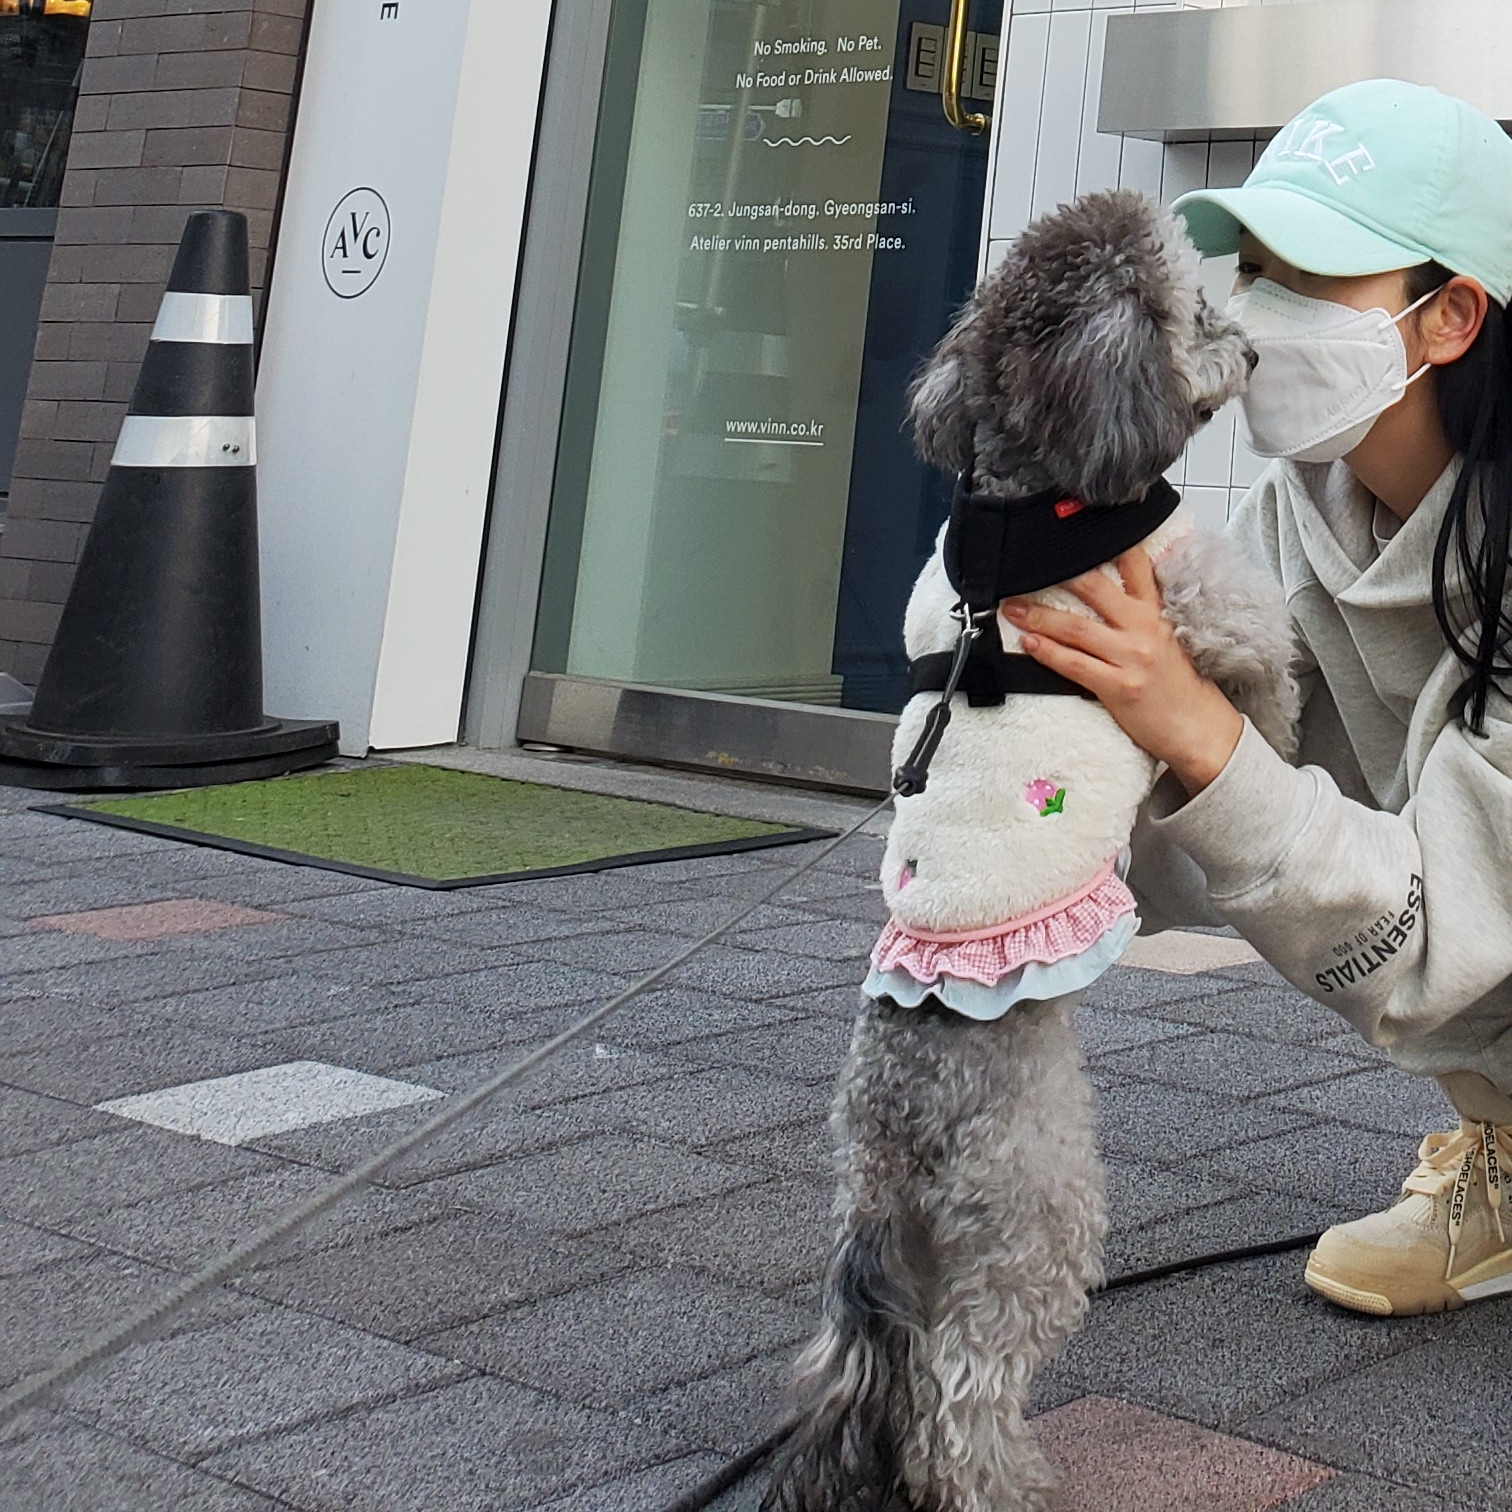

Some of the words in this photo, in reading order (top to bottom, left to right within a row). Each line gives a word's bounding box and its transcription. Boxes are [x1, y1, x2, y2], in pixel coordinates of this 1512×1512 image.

[754, 40, 771, 56] No
[837, 37, 855, 52] No
[858, 36, 882, 51] Pet.
[736, 73, 753, 88] No
[756, 70, 786, 87] Food
[788, 74, 801, 86] or
[804, 69, 836, 85] Drink
[840, 65, 894, 83] Allowed.
[329, 211, 382, 260] AVC
[690, 235, 731, 251] Atelier
[734, 236, 760, 250] vinn
[832, 234, 863, 250] 35rd
[866, 234, 906, 250] Place.
[726, 417, 824, 437] www.vinn.co.kr
[1315, 872, 1422, 993] ESSENTIALS
[1367, 910, 1395, 936] FEAR
[1332, 941, 1353, 957] GOD
[1354, 932, 1368, 946] OF
